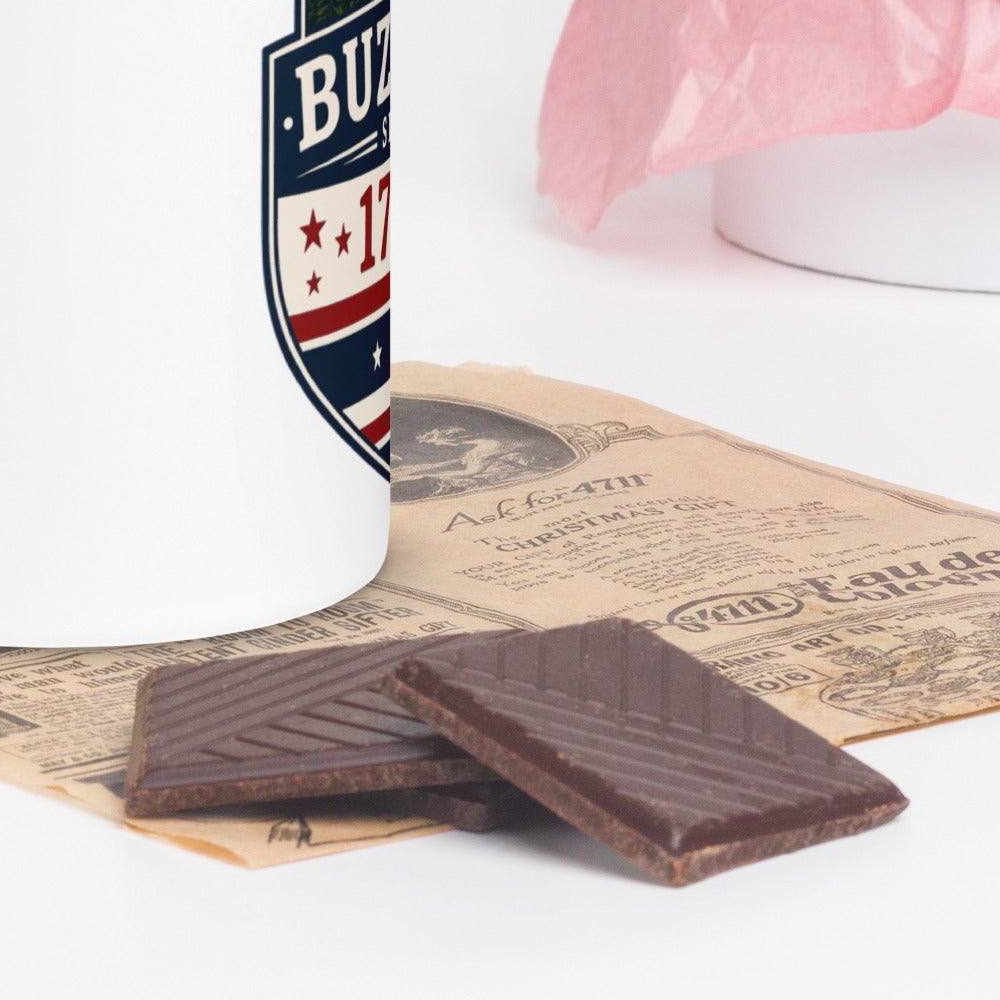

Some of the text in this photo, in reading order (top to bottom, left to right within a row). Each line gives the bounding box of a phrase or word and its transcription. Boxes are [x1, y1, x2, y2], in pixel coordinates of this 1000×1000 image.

[440, 498, 516, 534] Ask
[522, 490, 569, 510] for
[473, 534, 520, 546] The
[544, 510, 588, 528] most
[495, 506, 665, 552] CHRISTMAS
[673, 500, 737, 512] GIFT
[453, 560, 510, 576] YOUR
[802, 560, 935, 592] Eau
[939, 550, 1000, 571] de
[246, 625, 339, 651] CINDER
[333, 606, 425, 632] SIFTER
[419, 620, 457, 633] GIFT
[791, 632, 842, 652] ART
[14, 676, 64, 691] man
[72, 659, 145, 679] would
[30, 659, 91, 677] what
[38, 687, 67, 696] to
